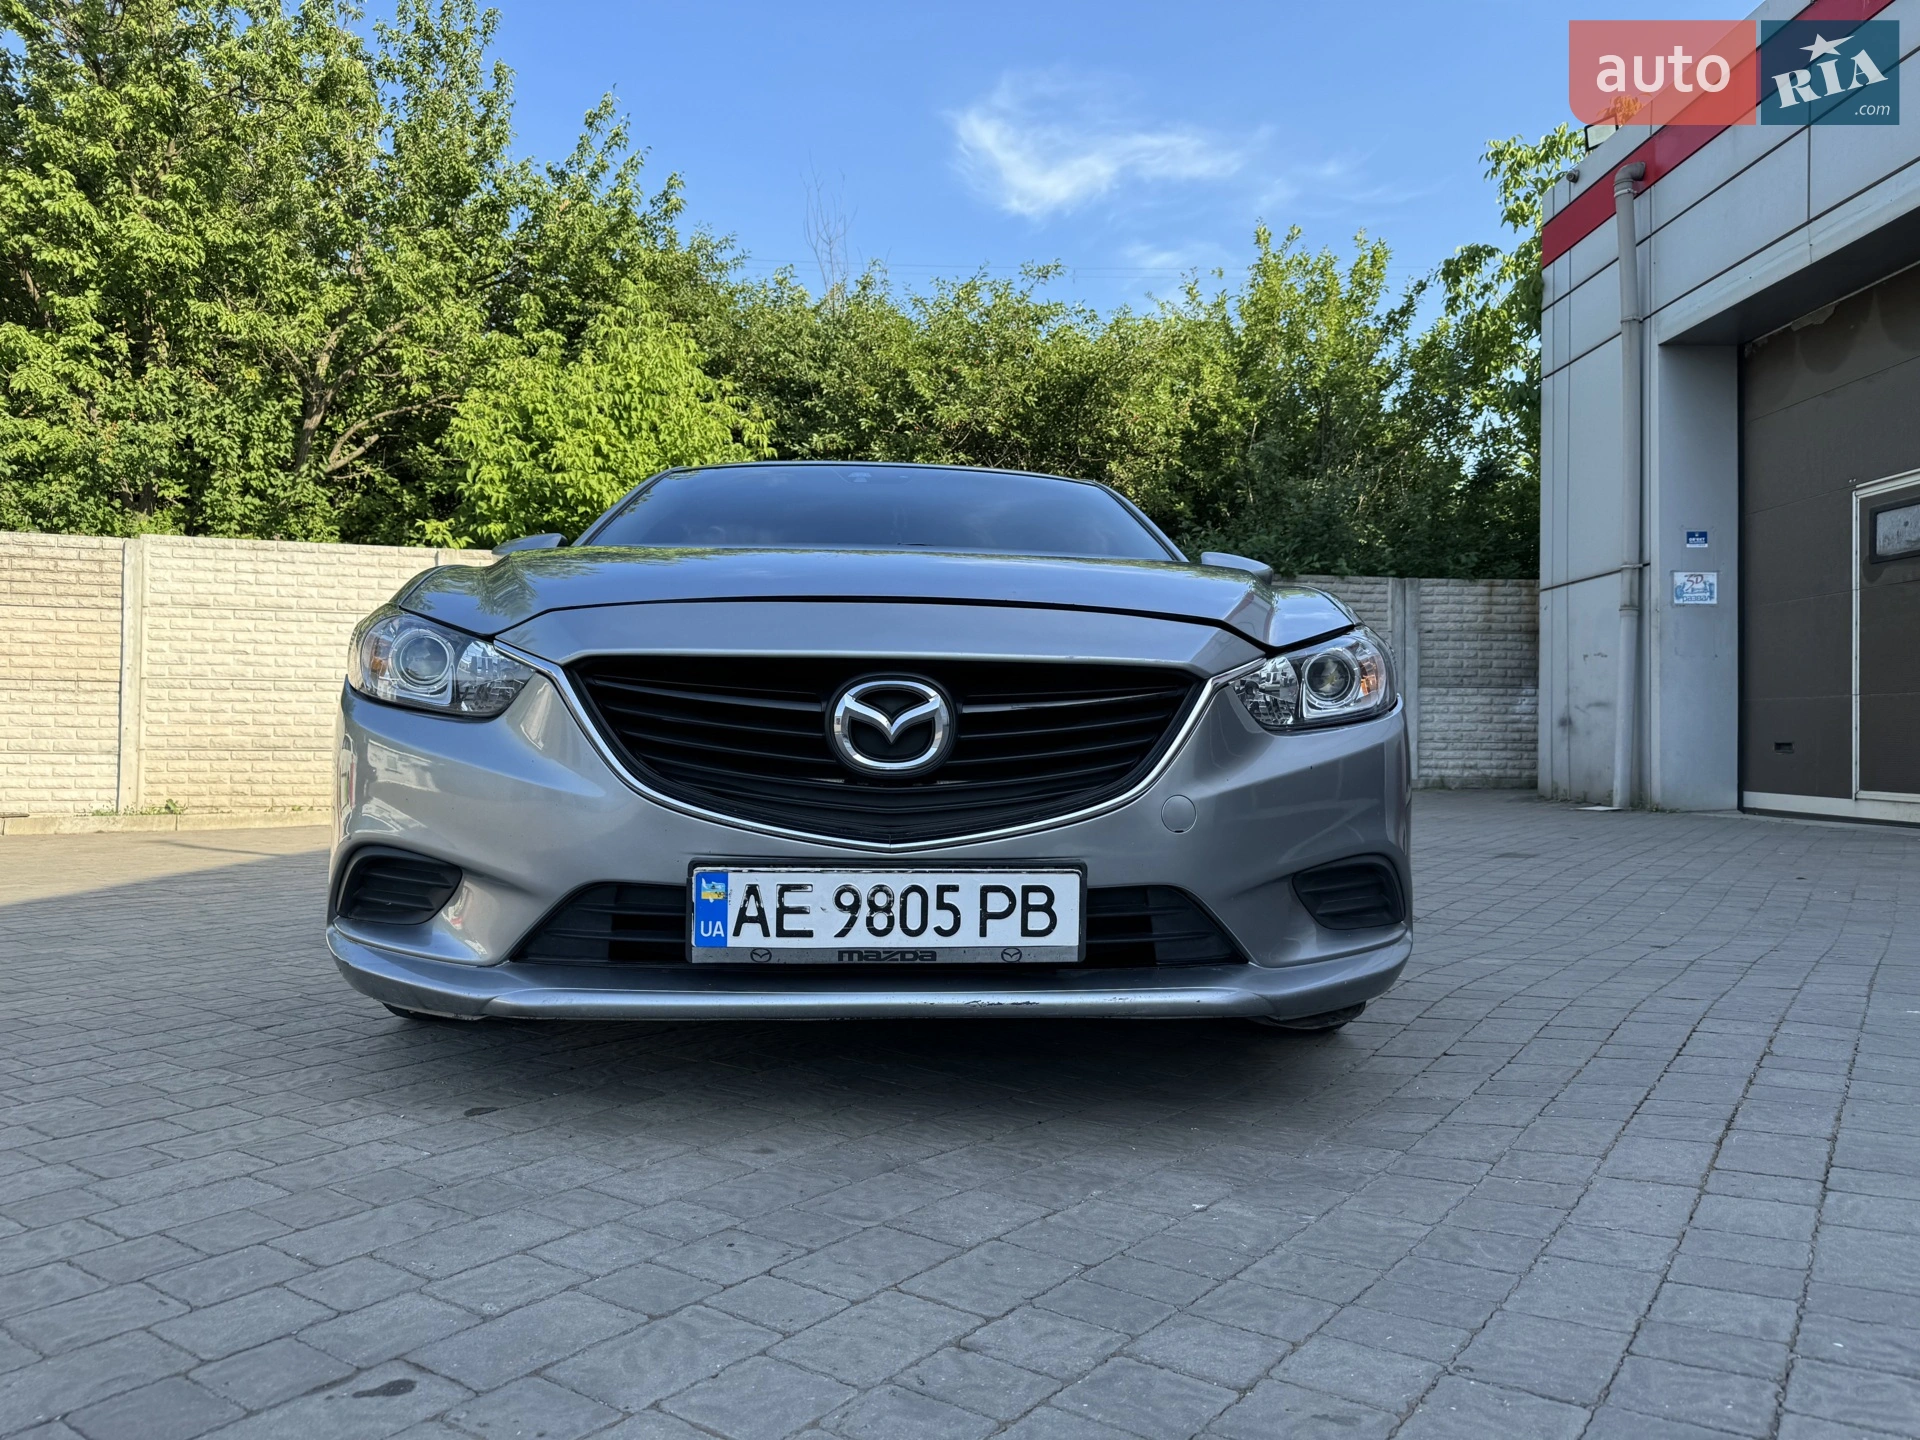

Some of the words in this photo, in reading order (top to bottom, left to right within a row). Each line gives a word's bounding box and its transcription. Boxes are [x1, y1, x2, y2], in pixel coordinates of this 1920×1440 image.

[732, 883, 814, 938] AE
[833, 883, 961, 938] 9805
[979, 883, 1058, 938] PB
[700, 920, 725, 937] UA
[837, 950, 937, 962] mazda
